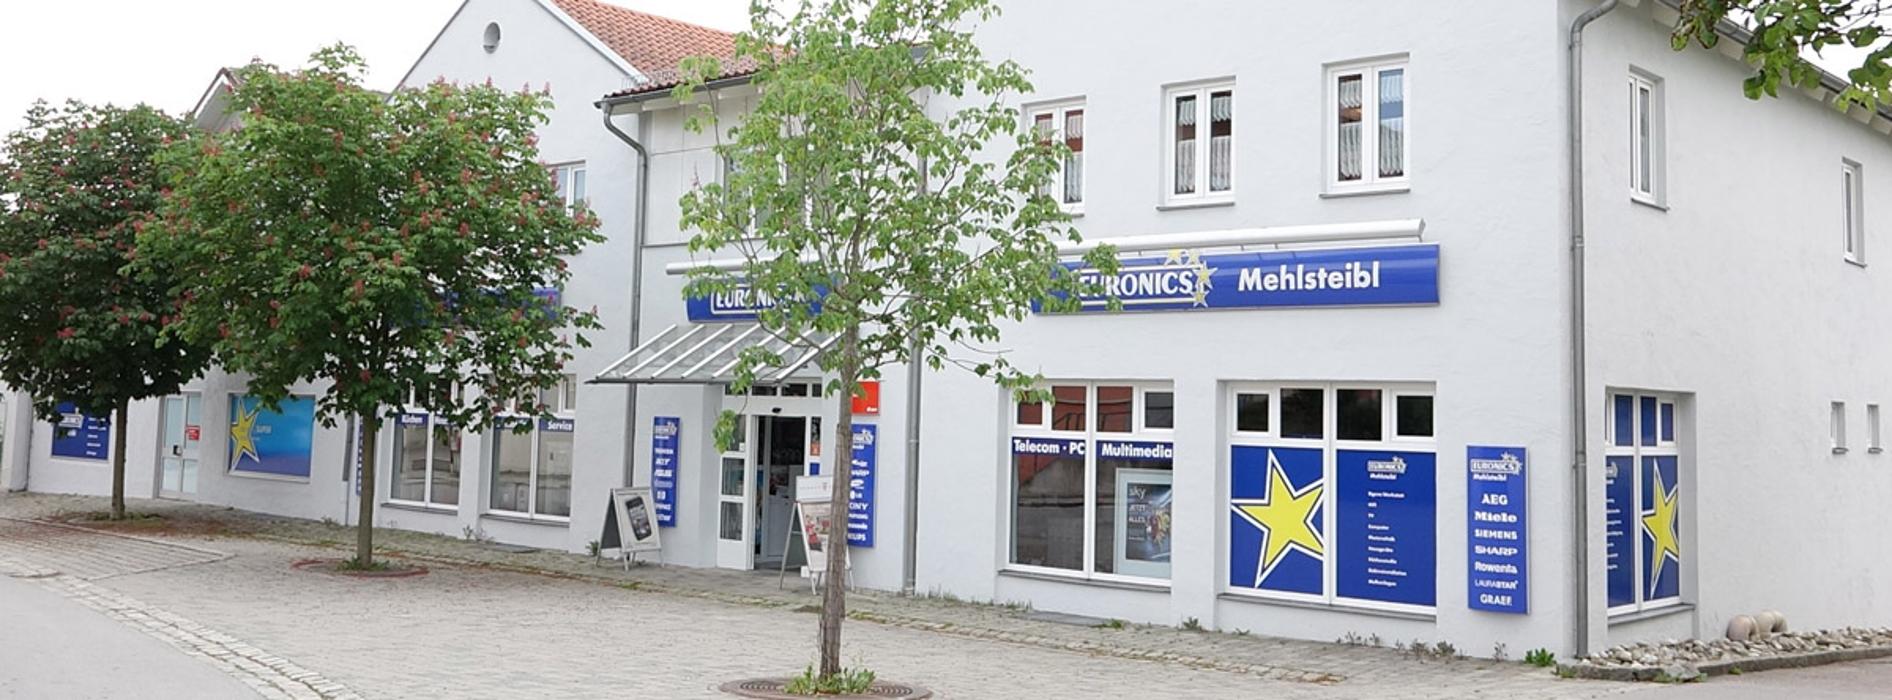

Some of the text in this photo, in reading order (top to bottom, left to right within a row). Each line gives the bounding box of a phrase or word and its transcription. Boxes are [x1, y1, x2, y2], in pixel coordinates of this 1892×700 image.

[1237, 260, 1380, 292] Mehlsteibl
[547, 420, 573, 431] Service
[1013, 439, 1086, 455] Telecom PC
[1101, 442, 1173, 459] Multimedia
[1481, 493, 1508, 505] AEG
[1474, 511, 1518, 523] Miele
[1474, 529, 1517, 540] SIEMENS
[1474, 545, 1518, 556] SHARP
[1474, 561, 1518, 574] Rowenta
